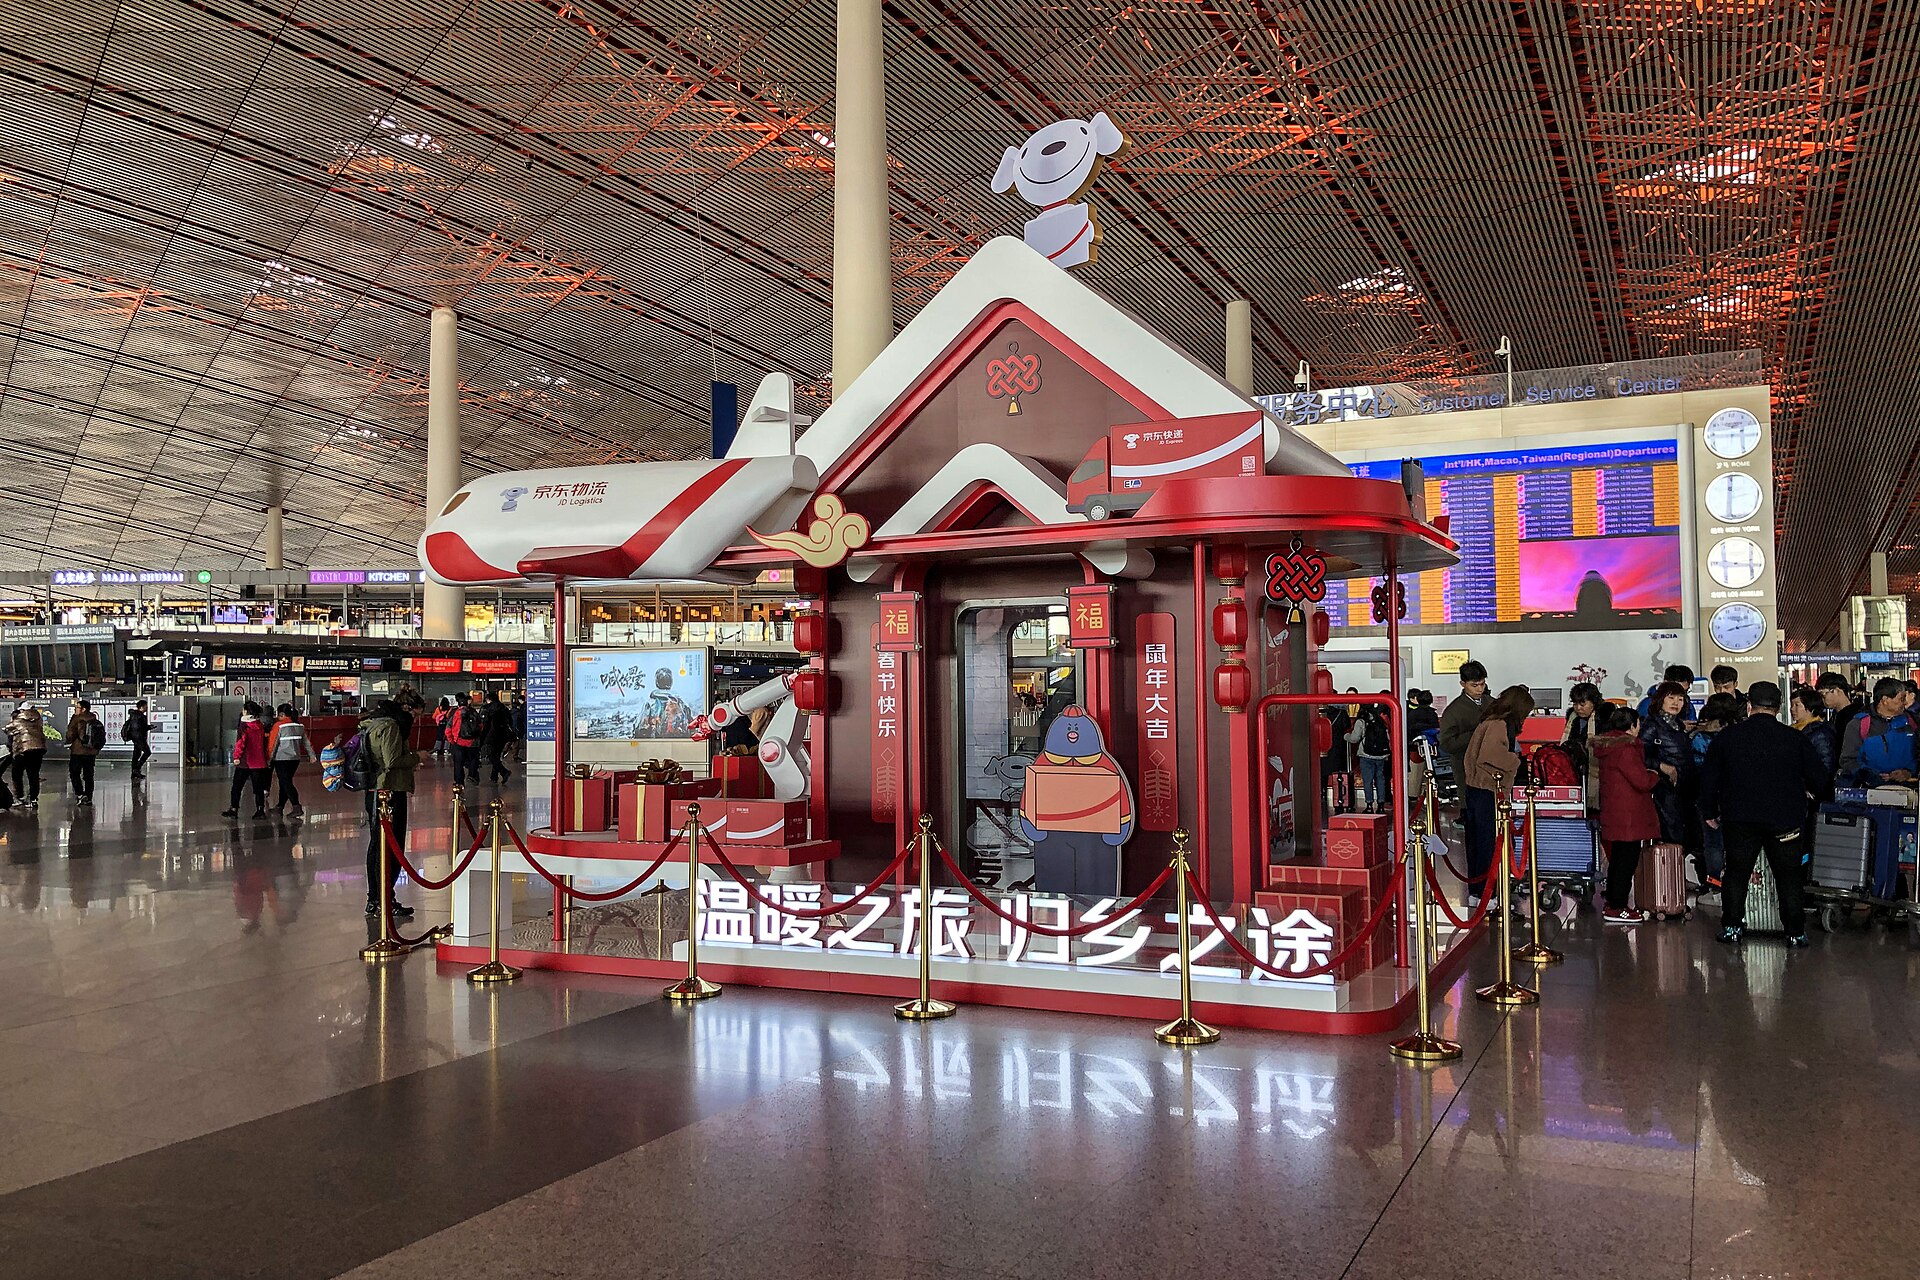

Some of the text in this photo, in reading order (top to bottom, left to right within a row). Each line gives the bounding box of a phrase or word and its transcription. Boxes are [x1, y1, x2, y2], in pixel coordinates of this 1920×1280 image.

[1420, 377, 1683, 413] Customer Service Center
[1258, 389, 1400, 426] 服务中心
[1143, 429, 1184, 442] 京东快递
[533, 481, 609, 500] 京东物流
[570, 497, 603, 507] Logistics
[101, 571, 137, 584] MAJIA
[140, 571, 184, 583] SHUMAI
[368, 572, 410, 582] KITCHEN
[885, 609, 909, 635] 福
[1076, 603, 1103, 630] 福
[175, 655, 184, 668] F
[192, 657, 207, 669] 35
[877, 651, 897, 738] 春节快乐
[1145, 643, 1169, 740] 鼠年大吉
[695, 878, 1336, 984] 温暖之旅 归乡之途
